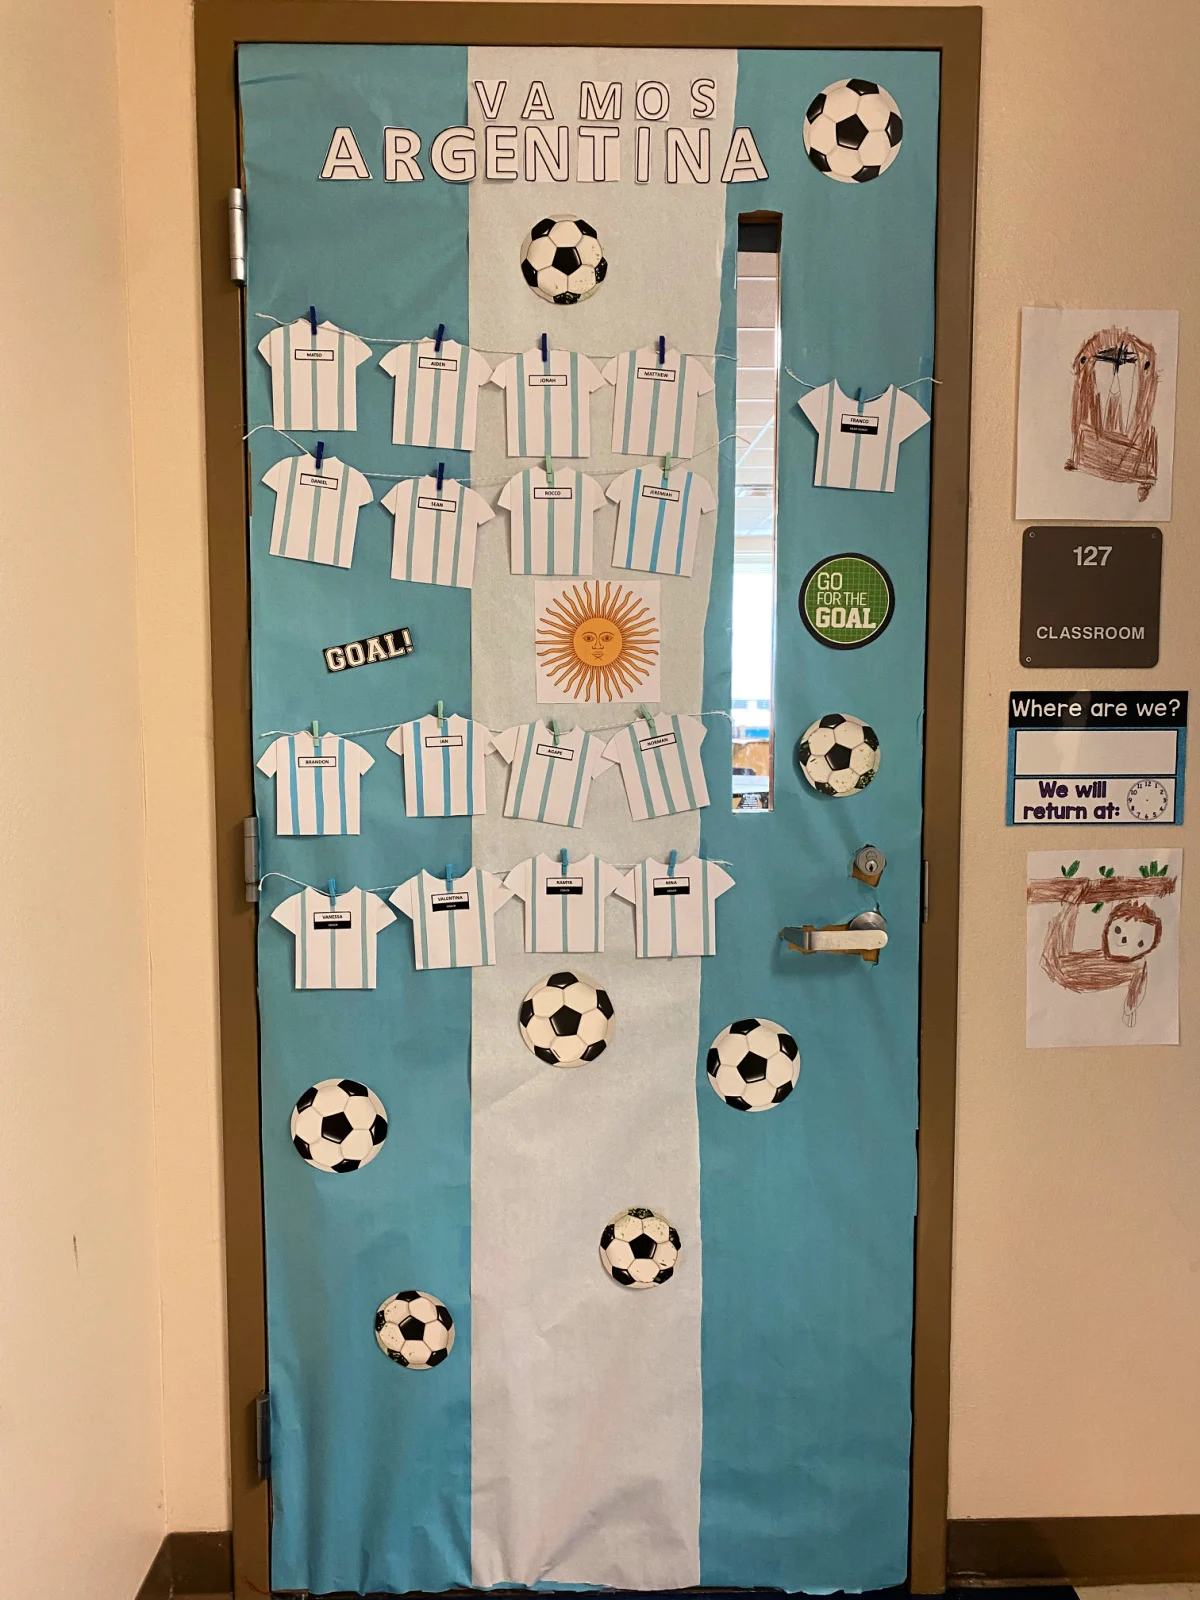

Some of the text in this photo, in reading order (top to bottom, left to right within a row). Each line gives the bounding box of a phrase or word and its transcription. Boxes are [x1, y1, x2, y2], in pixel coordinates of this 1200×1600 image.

[474, 78, 716, 121] VAMOS
[319, 125, 769, 183] ARGENTINA
[310, 478, 328, 486] DANIEL
[1073, 545, 1113, 566] 127
[817, 572, 843, 590] GO
[816, 591, 868, 606] FOR THE
[815, 607, 877, 628] GOAL
[1036, 626, 1146, 640] CLASSROOM
[324, 628, 414, 673] GOAL!
[1012, 698, 1181, 718] Where are we?
[1039, 780, 1107, 798] We will
[1023, 802, 1121, 820] return at:
